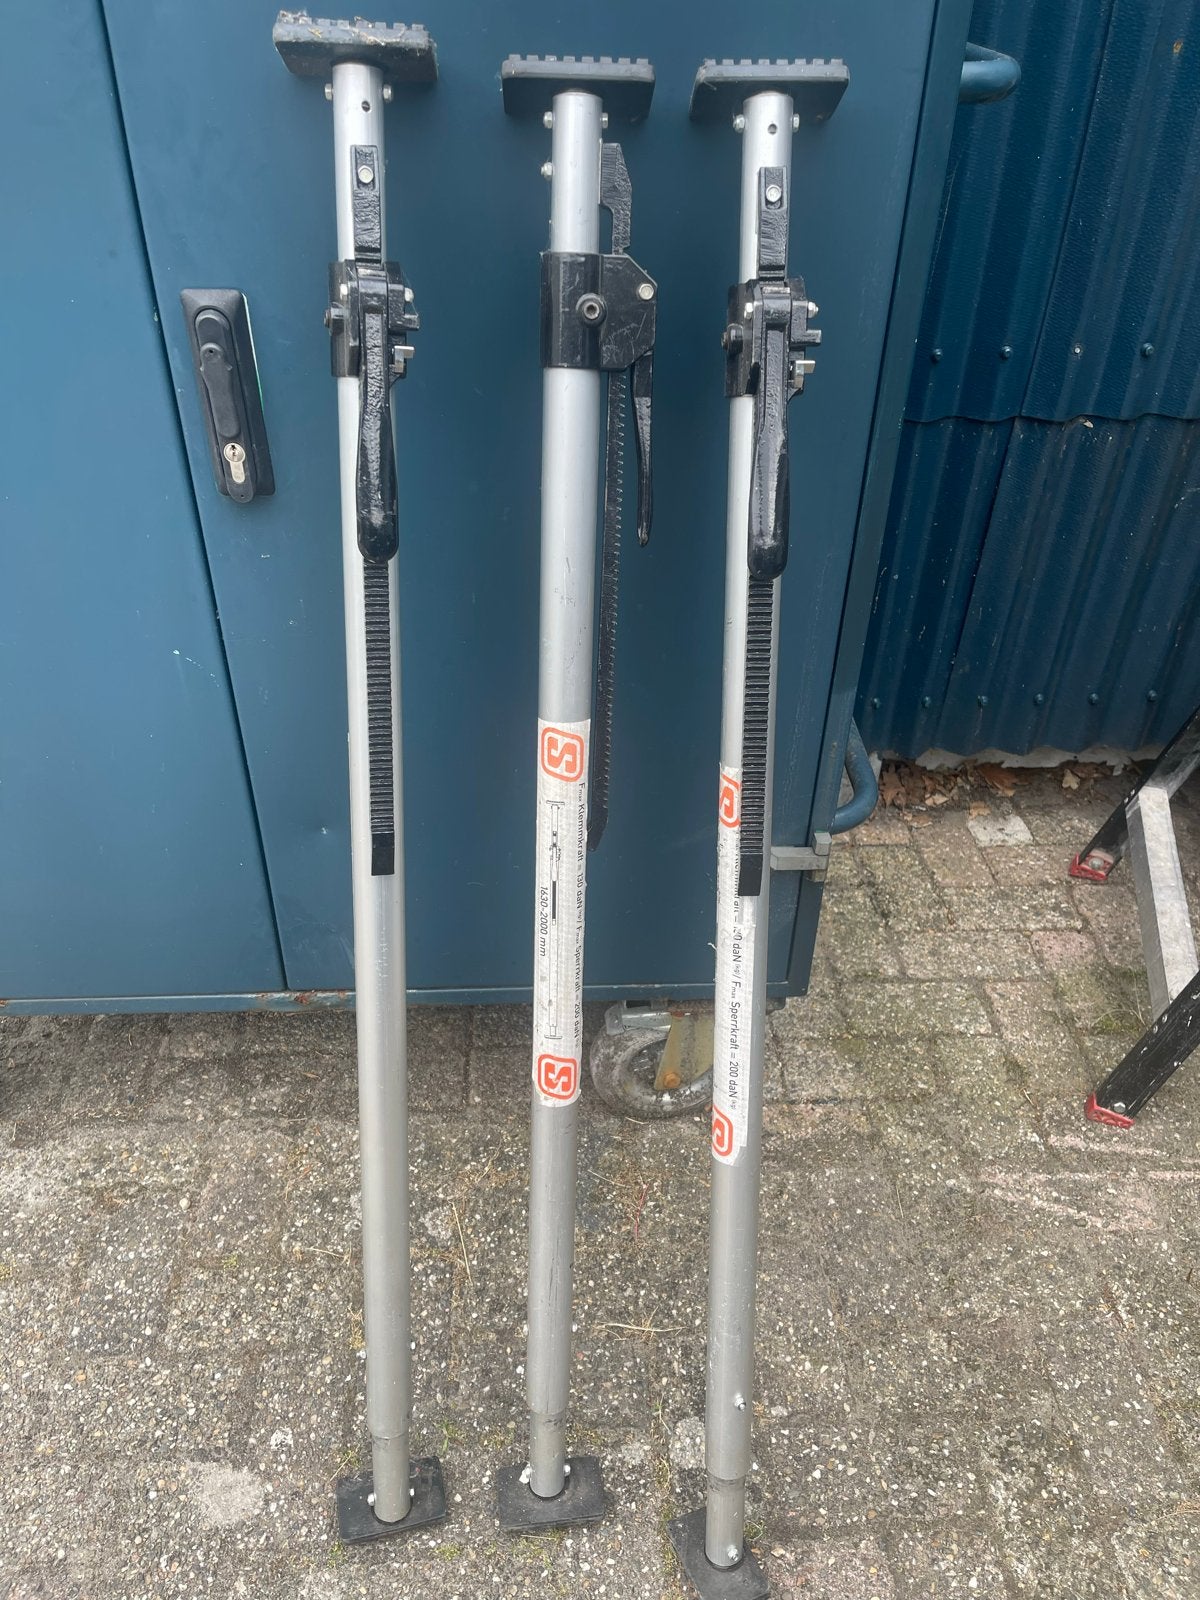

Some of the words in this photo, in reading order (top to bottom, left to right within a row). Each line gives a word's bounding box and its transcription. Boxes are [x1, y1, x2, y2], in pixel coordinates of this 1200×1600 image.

[540, 886, 549, 935] 1630-2000
[540, 937, 546, 957] mm
[732, 943, 742, 963] daN
[729, 1001, 741, 1050] Sperrkraft
[729, 1061, 739, 1078] 200
[728, 1080, 738, 1099] daN
